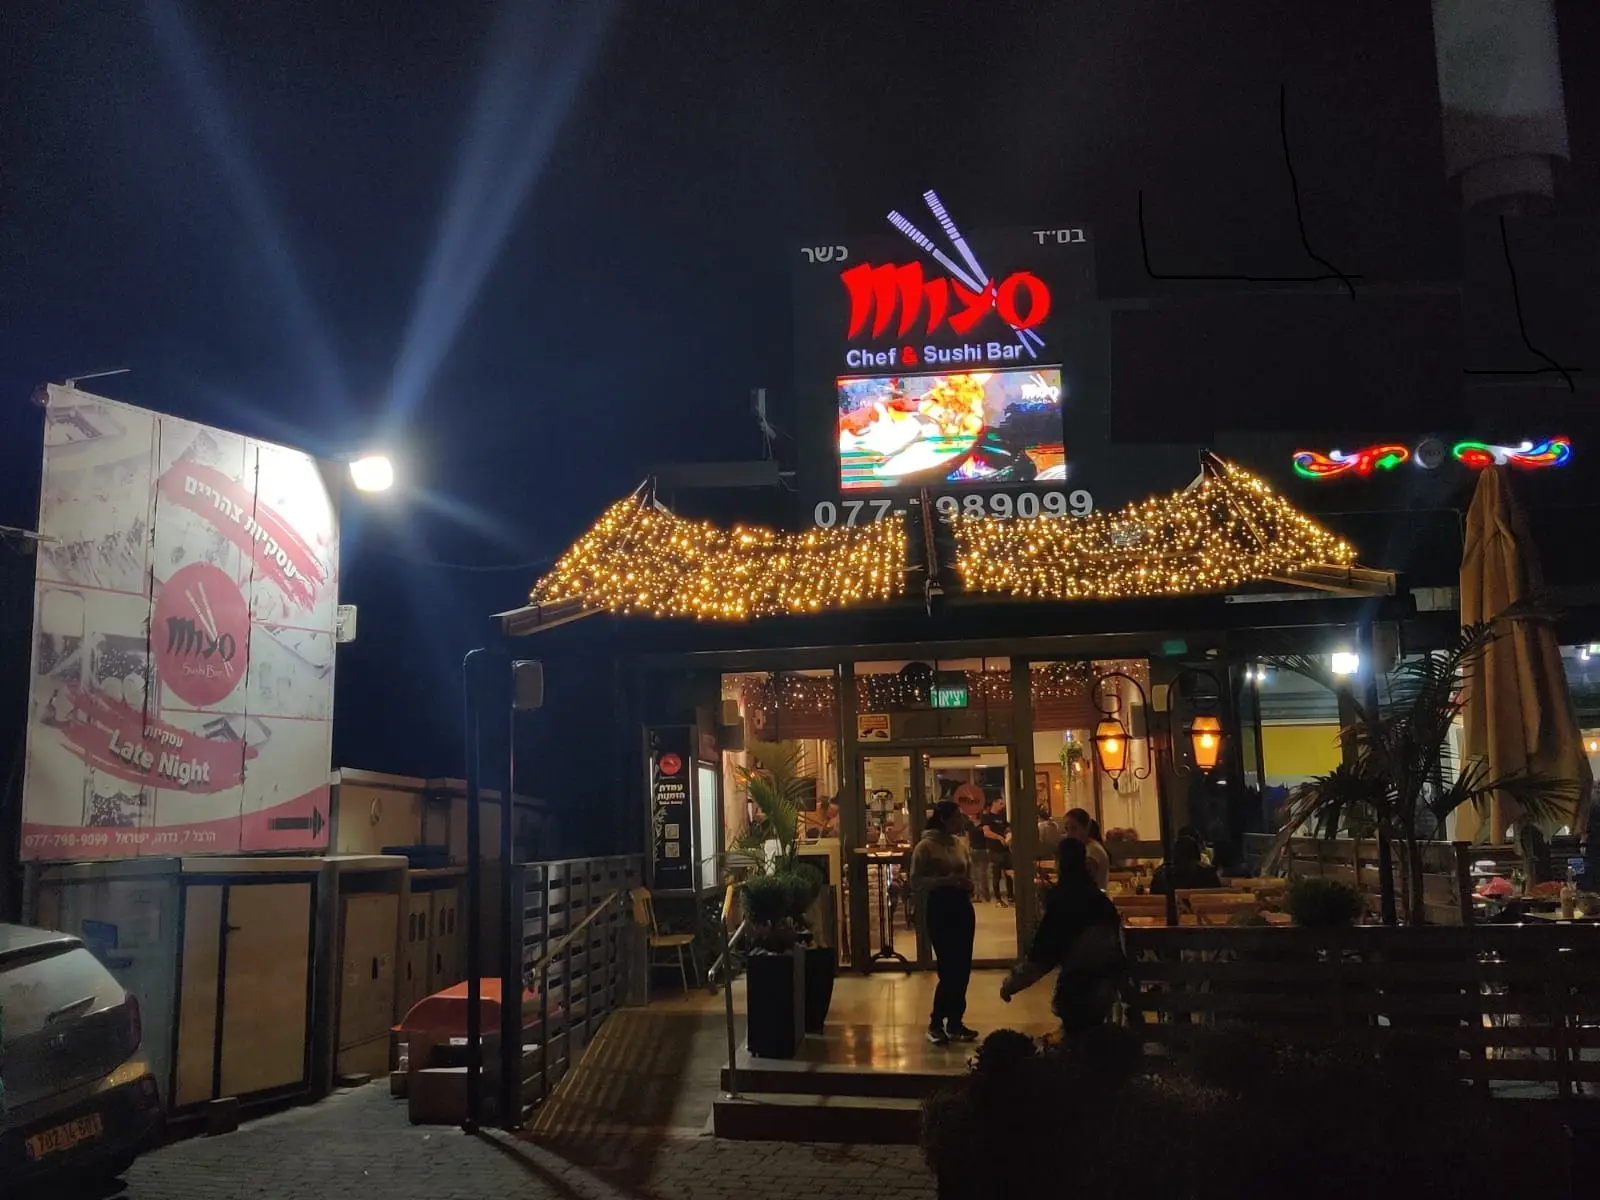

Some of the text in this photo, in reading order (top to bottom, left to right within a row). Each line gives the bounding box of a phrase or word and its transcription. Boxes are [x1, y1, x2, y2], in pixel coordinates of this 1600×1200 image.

[801, 245, 848, 264] כשר
[846, 342, 1023, 368] Chef & Sushi Bar
[185, 476, 297, 578] עסקיות צהריים
[144, 725, 183, 747] עסקיות
[109, 729, 210, 785] Late Night
[24, 833, 108, 847] 077-798-9099
[115, 831, 149, 844] ישראל
